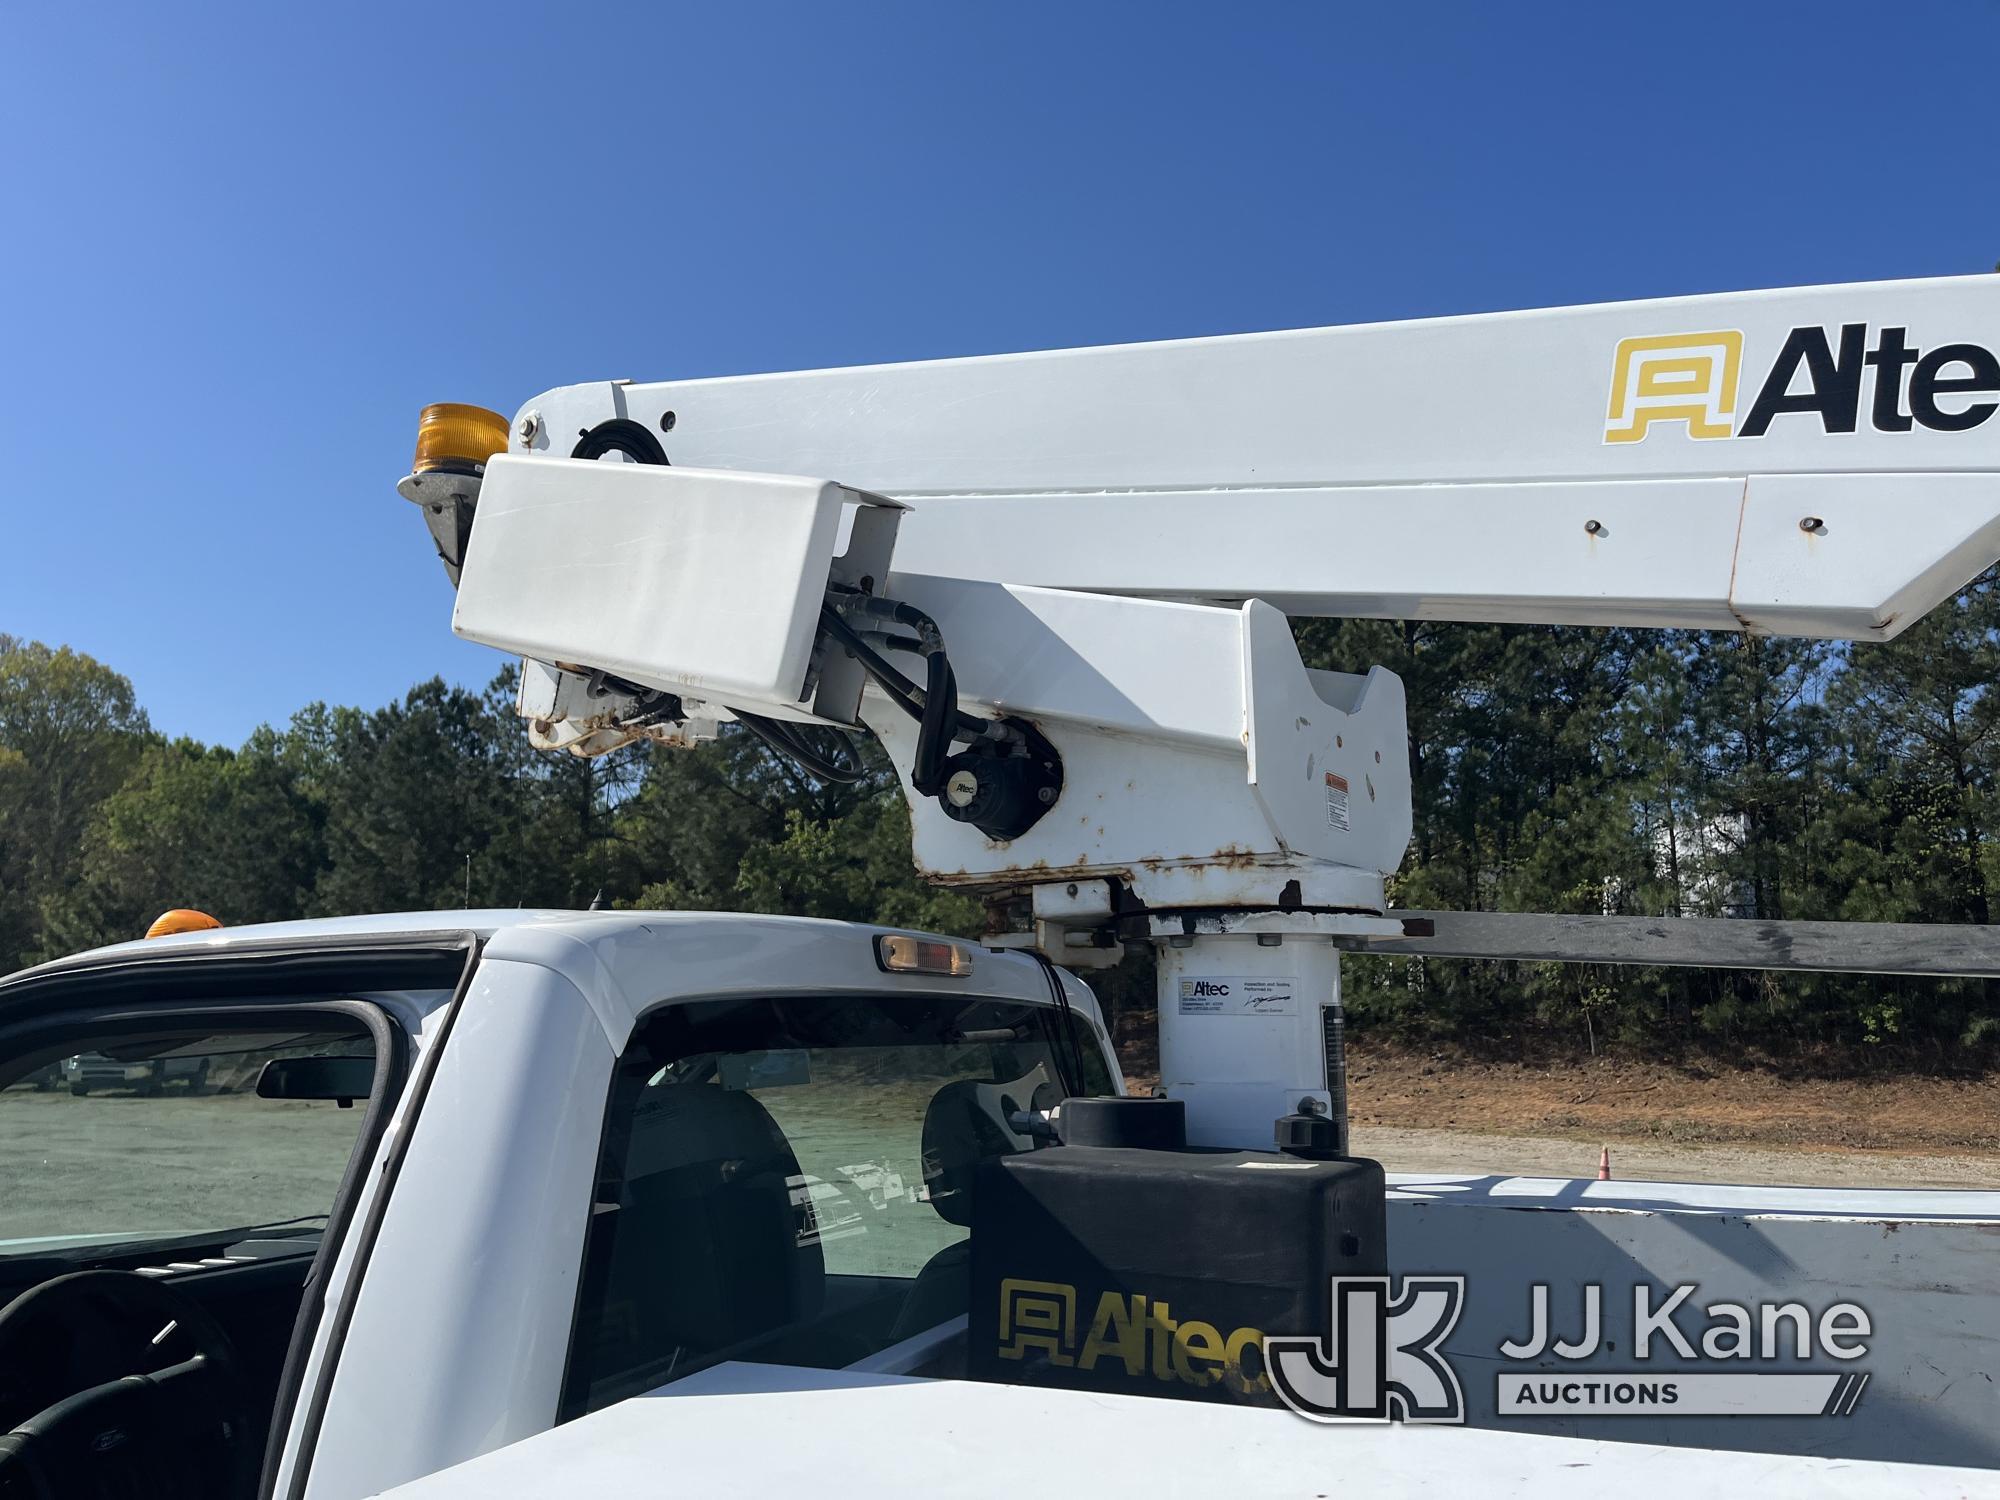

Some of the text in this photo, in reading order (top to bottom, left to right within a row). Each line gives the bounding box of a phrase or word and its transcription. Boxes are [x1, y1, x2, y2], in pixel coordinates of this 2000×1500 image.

[956, 783, 973, 793] Altec
[1194, 981, 1229, 996] Altec
[1077, 1291, 1272, 1394] Altec
